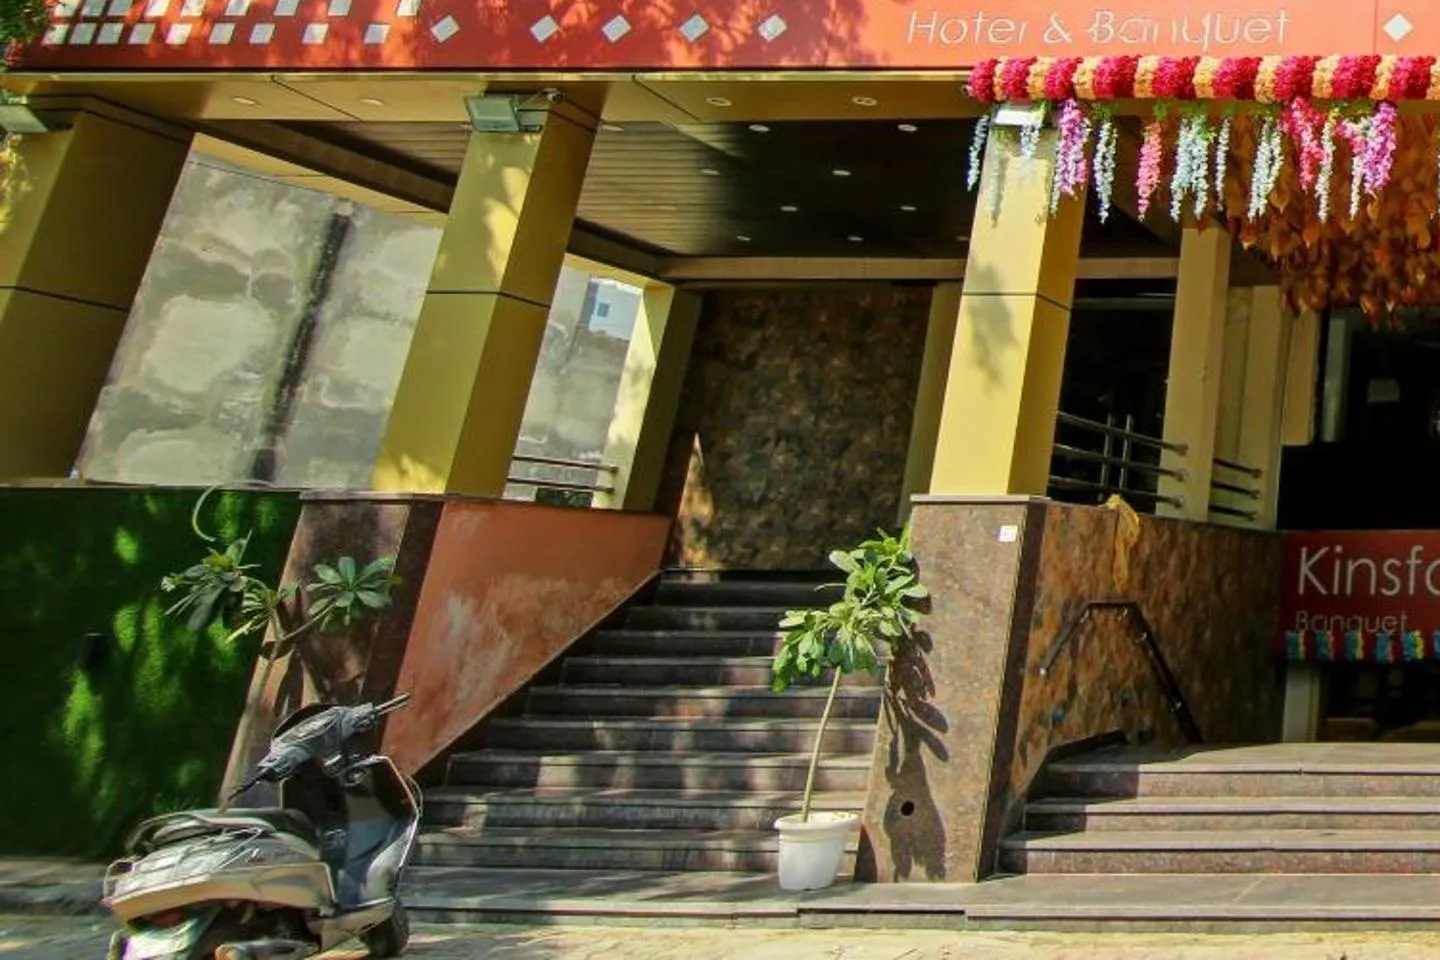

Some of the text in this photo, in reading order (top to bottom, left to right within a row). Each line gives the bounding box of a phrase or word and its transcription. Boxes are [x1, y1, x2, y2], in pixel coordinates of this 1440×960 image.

[1043, 11, 1073, 45] &
[1089, 9, 1290, 51] Banquet
[1294, 609, 1410, 634] Banquet
